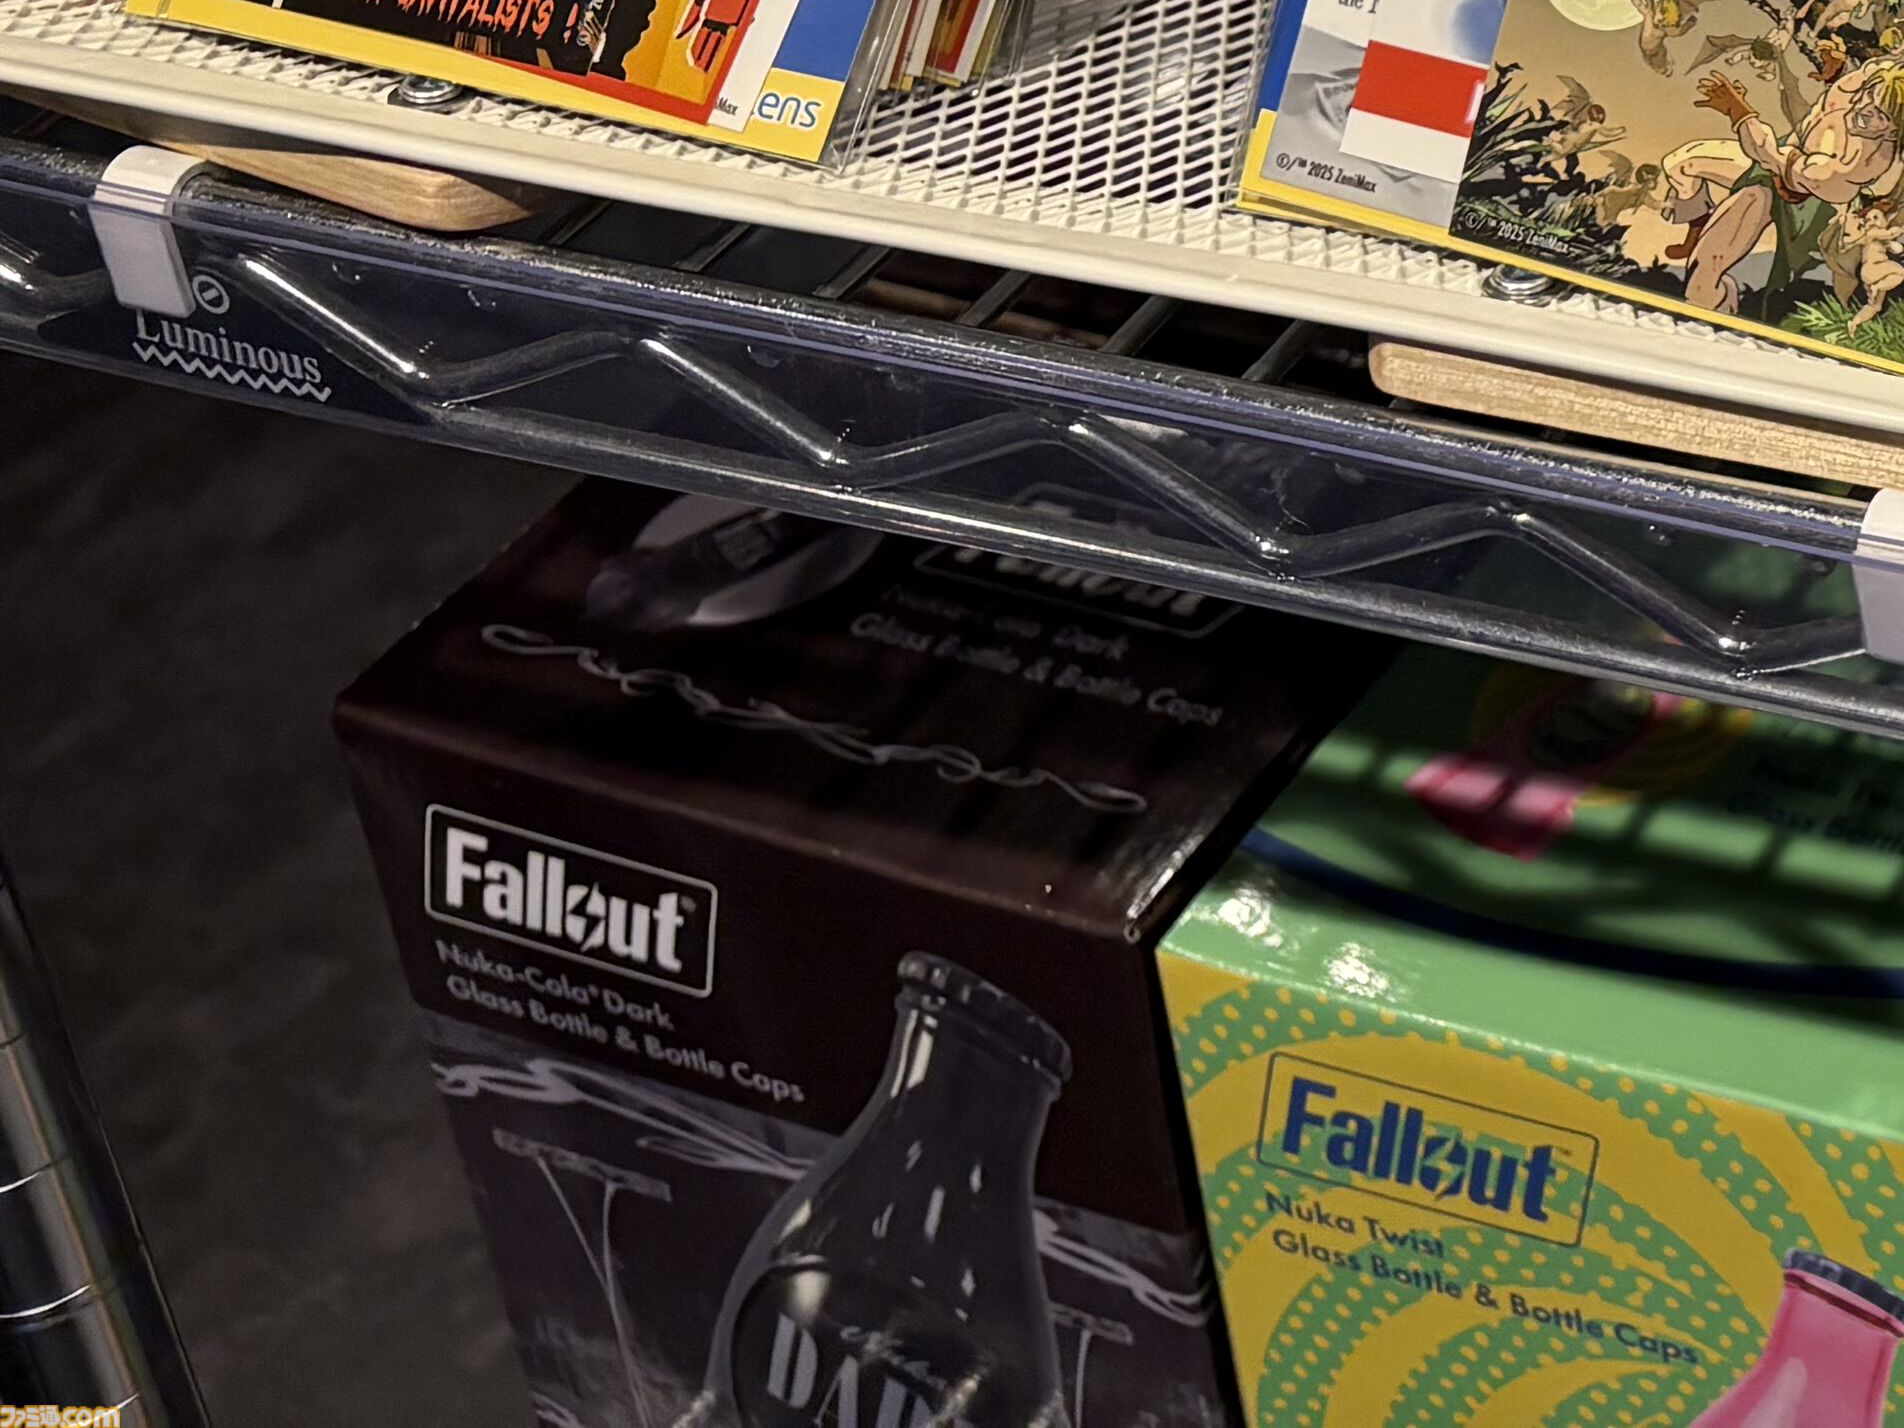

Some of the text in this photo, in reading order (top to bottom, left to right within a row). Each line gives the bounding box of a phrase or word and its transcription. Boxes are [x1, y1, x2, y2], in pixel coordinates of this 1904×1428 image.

[1307, 160, 1335, 181] 2025
[1335, 168, 1377, 194] ZeniMax
[1497, 220, 1525, 241] 2025
[135, 309, 323, 384] Luminous
[445, 825, 686, 976] Fallout
[445, 974, 806, 1104] Glass Bottle & Bottle Caps
[602, 988, 676, 1032] Dark
[1281, 1075, 1558, 1224] Fallout
[1264, 1191, 1445, 1260] Nuka Twist
[1271, 1228, 1699, 1367] Glass Bottle & Bottle Caps
